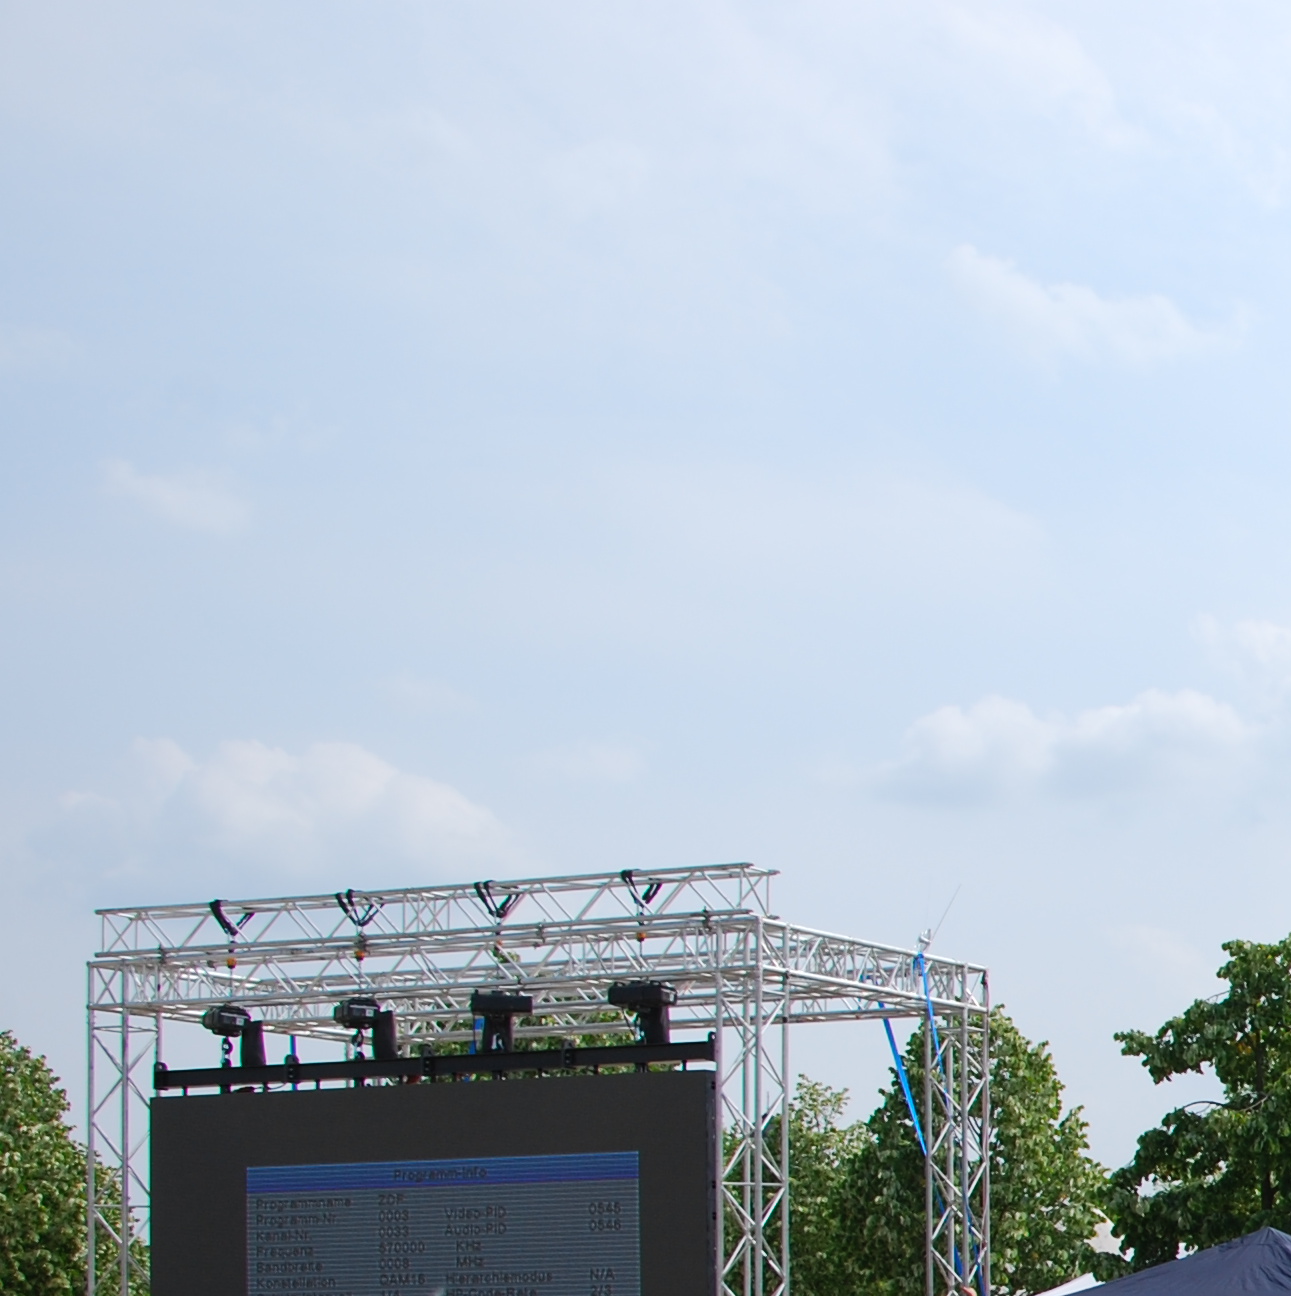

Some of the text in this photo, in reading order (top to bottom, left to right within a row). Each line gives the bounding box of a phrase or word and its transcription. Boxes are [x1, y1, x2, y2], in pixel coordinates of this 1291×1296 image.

[256, 1199, 351, 1212] Programmname
[378, 1194, 405, 1206] ZDF
[379, 1210, 409, 1222] 0003
[379, 1226, 409, 1238] 0033
[445, 1222, 507, 1235] Audio-PID
[456, 1240, 482, 1251] KHz
[256, 1246, 314, 1259] Frequenz
[379, 1258, 410, 1270] 0008
[456, 1256, 484, 1267] MHz
[256, 1262, 323, 1274] Bandbreite
[589, 1268, 615, 1280] N/A
[256, 1277, 337, 1289] Konstellation
[445, 1271, 553, 1284] Hierarchiemodus
[591, 1285, 613, 1296] 2/3
